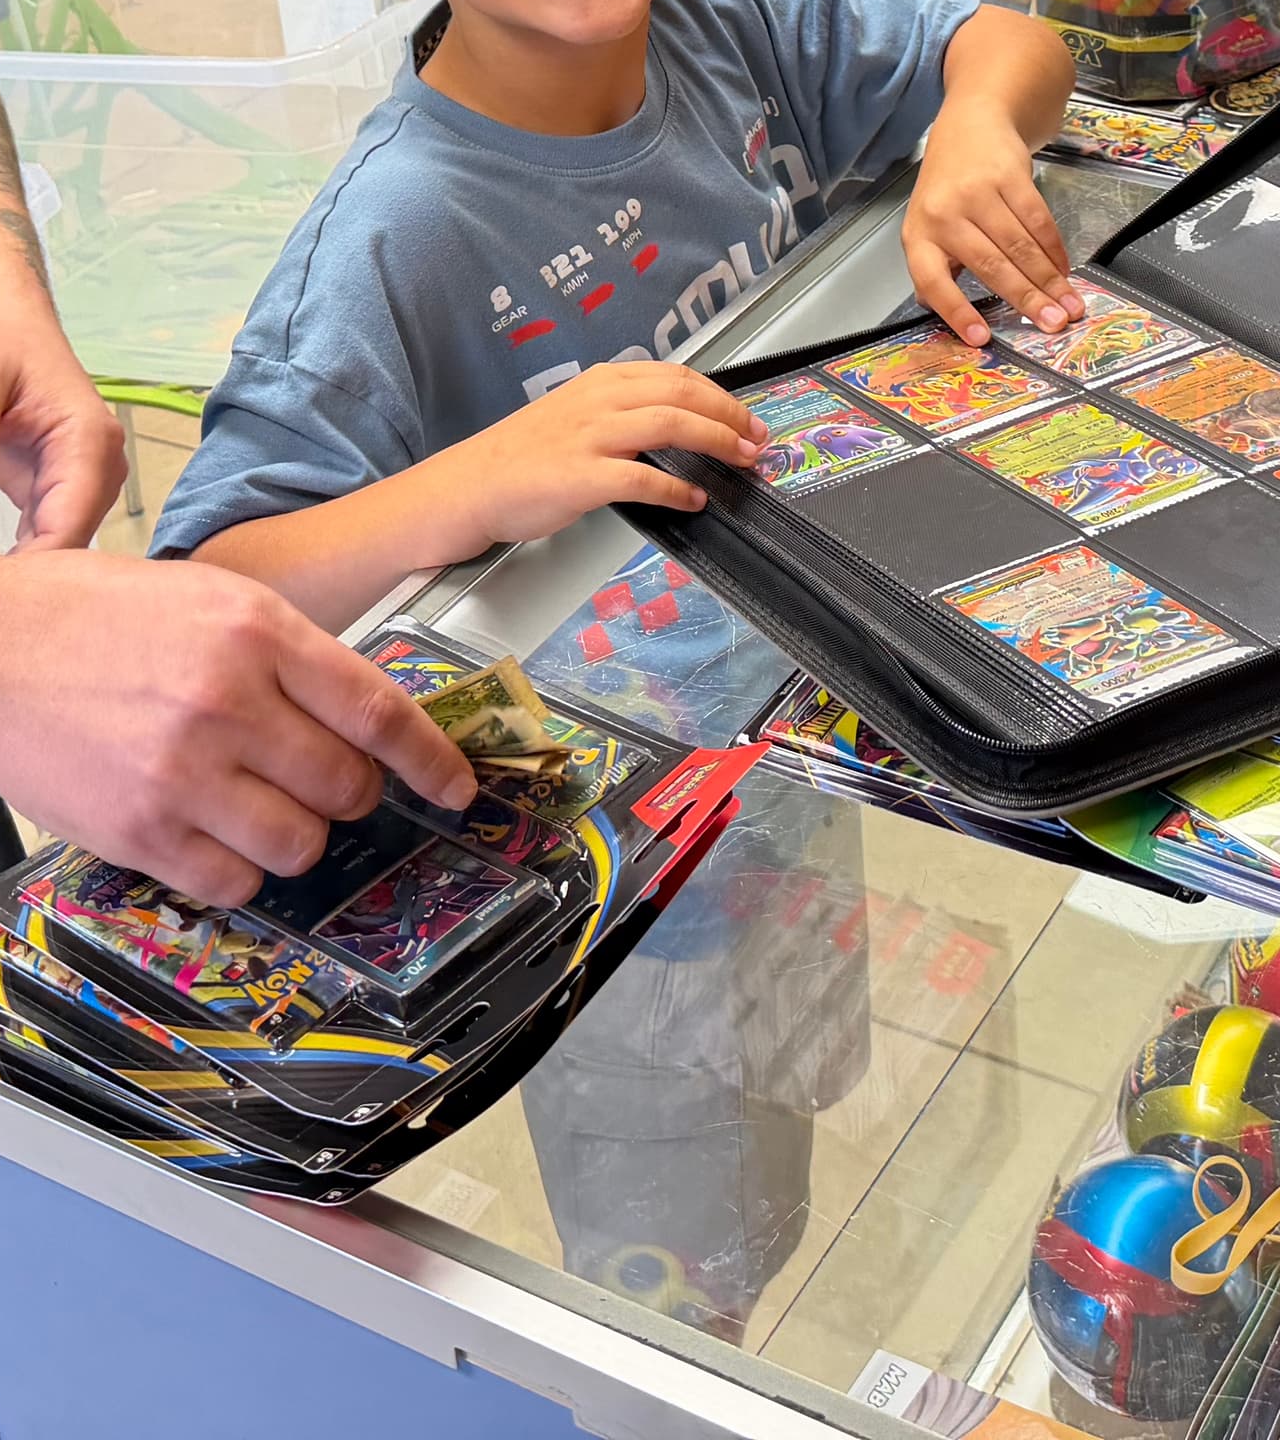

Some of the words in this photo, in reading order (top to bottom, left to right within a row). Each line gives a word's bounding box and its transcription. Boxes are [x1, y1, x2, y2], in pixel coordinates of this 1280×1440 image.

[596, 198, 642, 246] 199
[621, 229, 643, 252] MPH
[538, 245, 594, 289] 321
[560, 271, 590, 298] KM/H
[490, 286, 512, 313] 8
[491, 304, 528, 334] GEAR
[1097, 506, 1123, 518] 280
[1096, 674, 1127, 688] 300
[474, 893, 513, 922] Sneasel
[403, 959, 427, 980] 70
[270, 1012, 284, 1028] 6+
[867, 1362, 907, 1409] MAB
